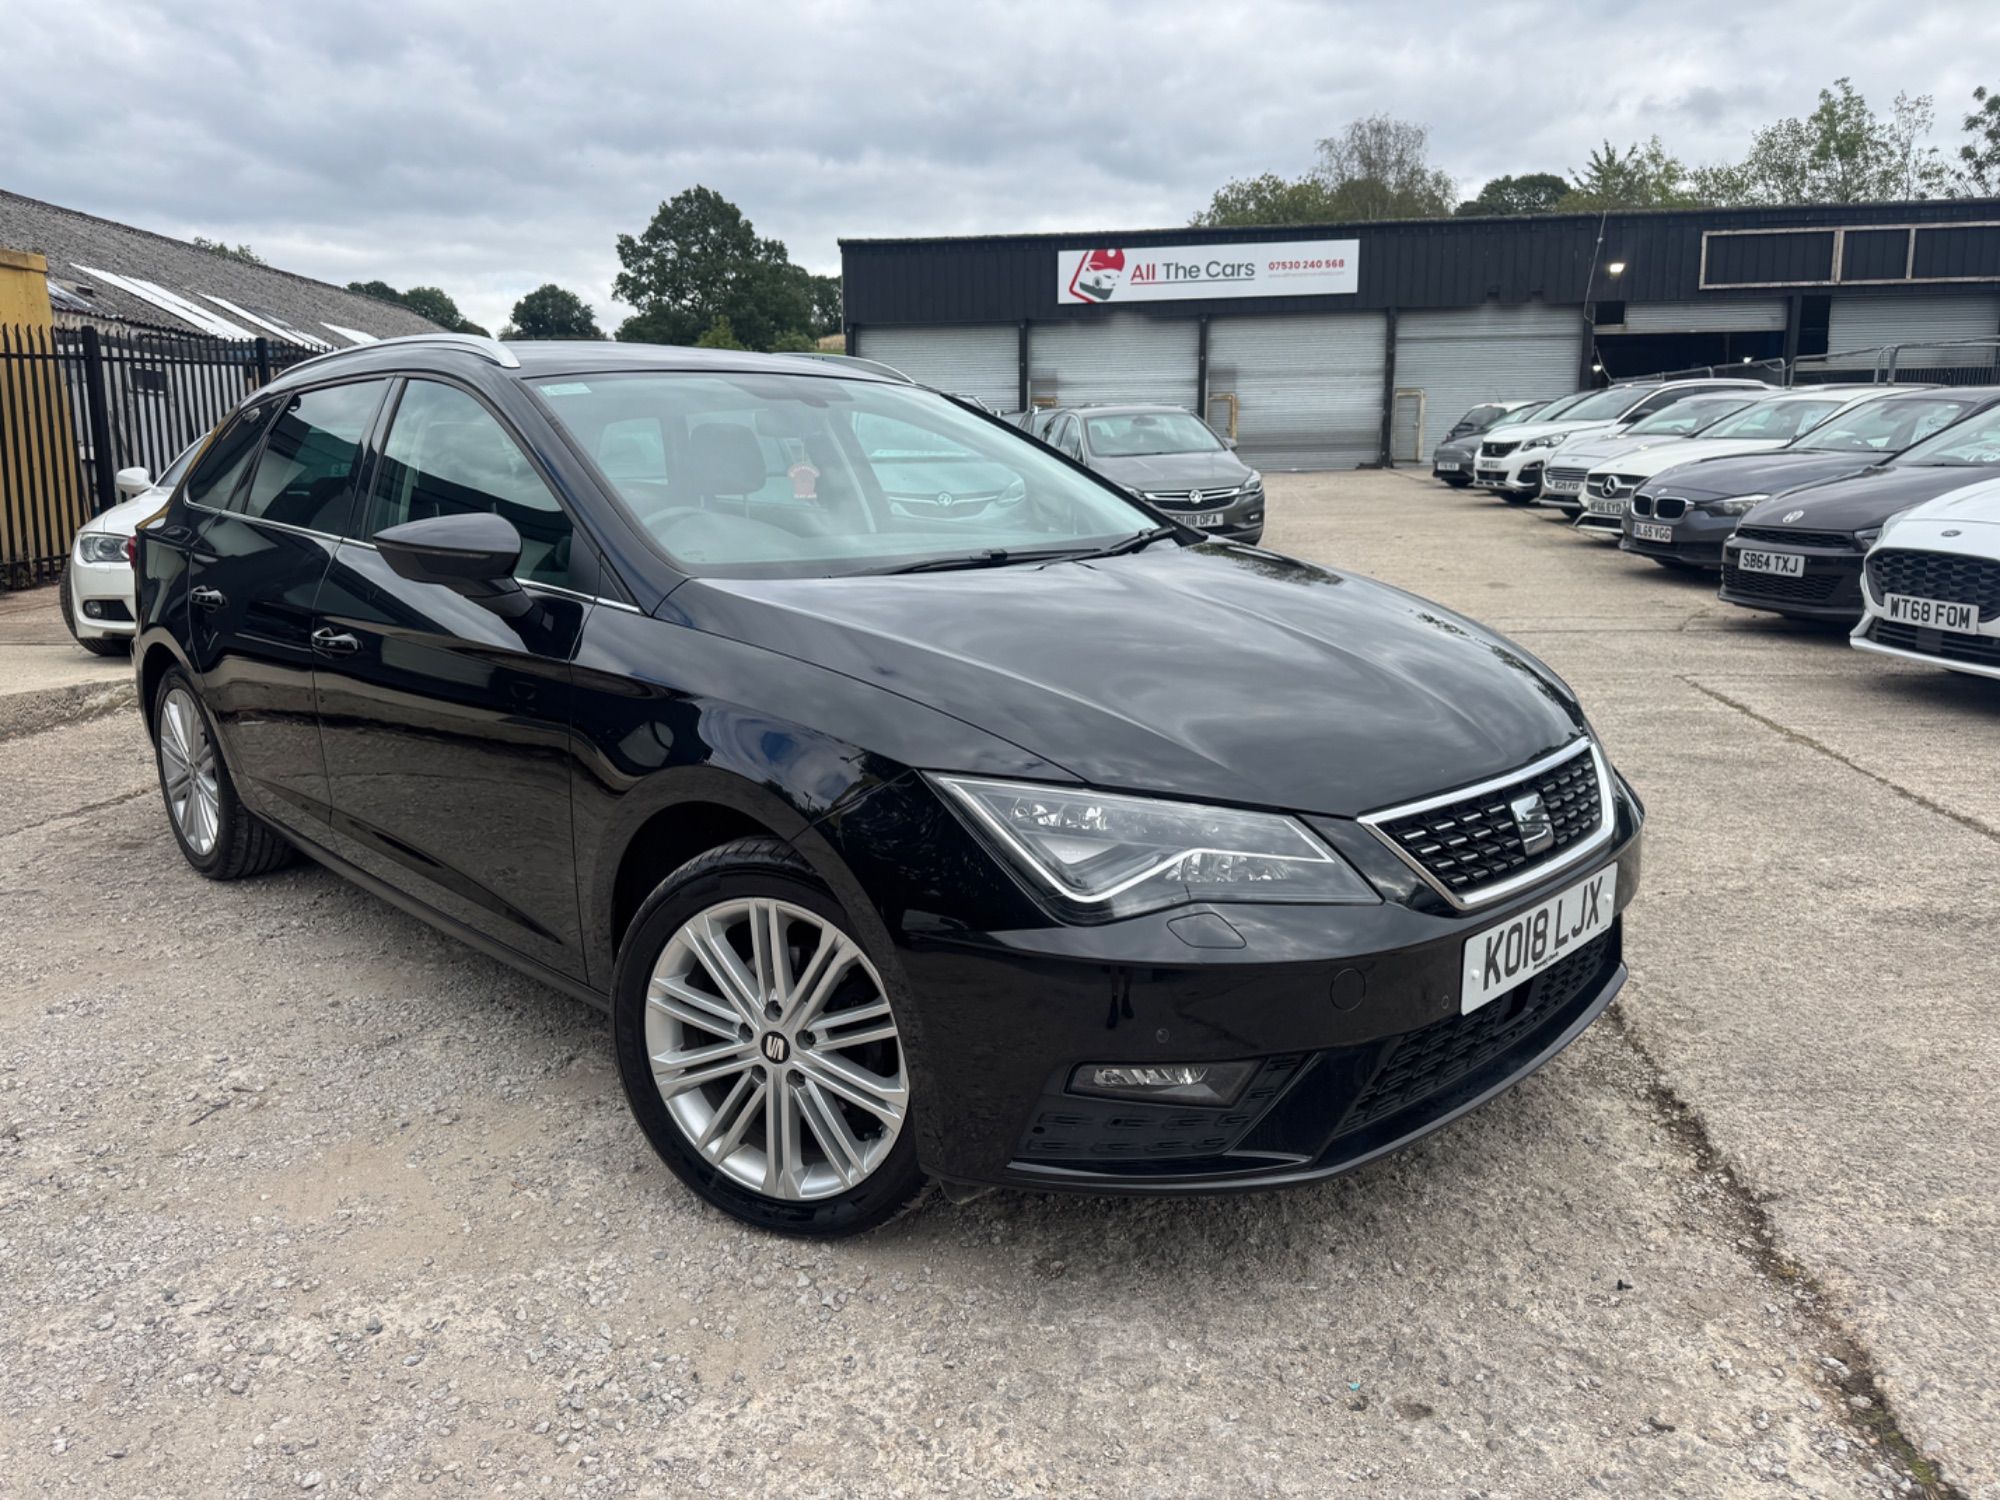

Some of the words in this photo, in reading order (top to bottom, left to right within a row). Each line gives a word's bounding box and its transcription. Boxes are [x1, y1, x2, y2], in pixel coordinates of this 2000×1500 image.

[1131, 263, 1156, 281] All
[1162, 262, 1201, 280] The
[1205, 260, 1255, 278] Cars
[1268, 261, 1300, 270] 07530
[1303, 260, 1322, 269] 240
[1325, 259, 1344, 268] 568
[1743, 552, 1771, 570] SB64
[1775, 555, 1799, 573] TXJ
[1890, 597, 1930, 622] WT68
[1935, 603, 1971, 629] FOM
[1483, 908, 1549, 991] KO18
[1554, 875, 1604, 950] LJX
